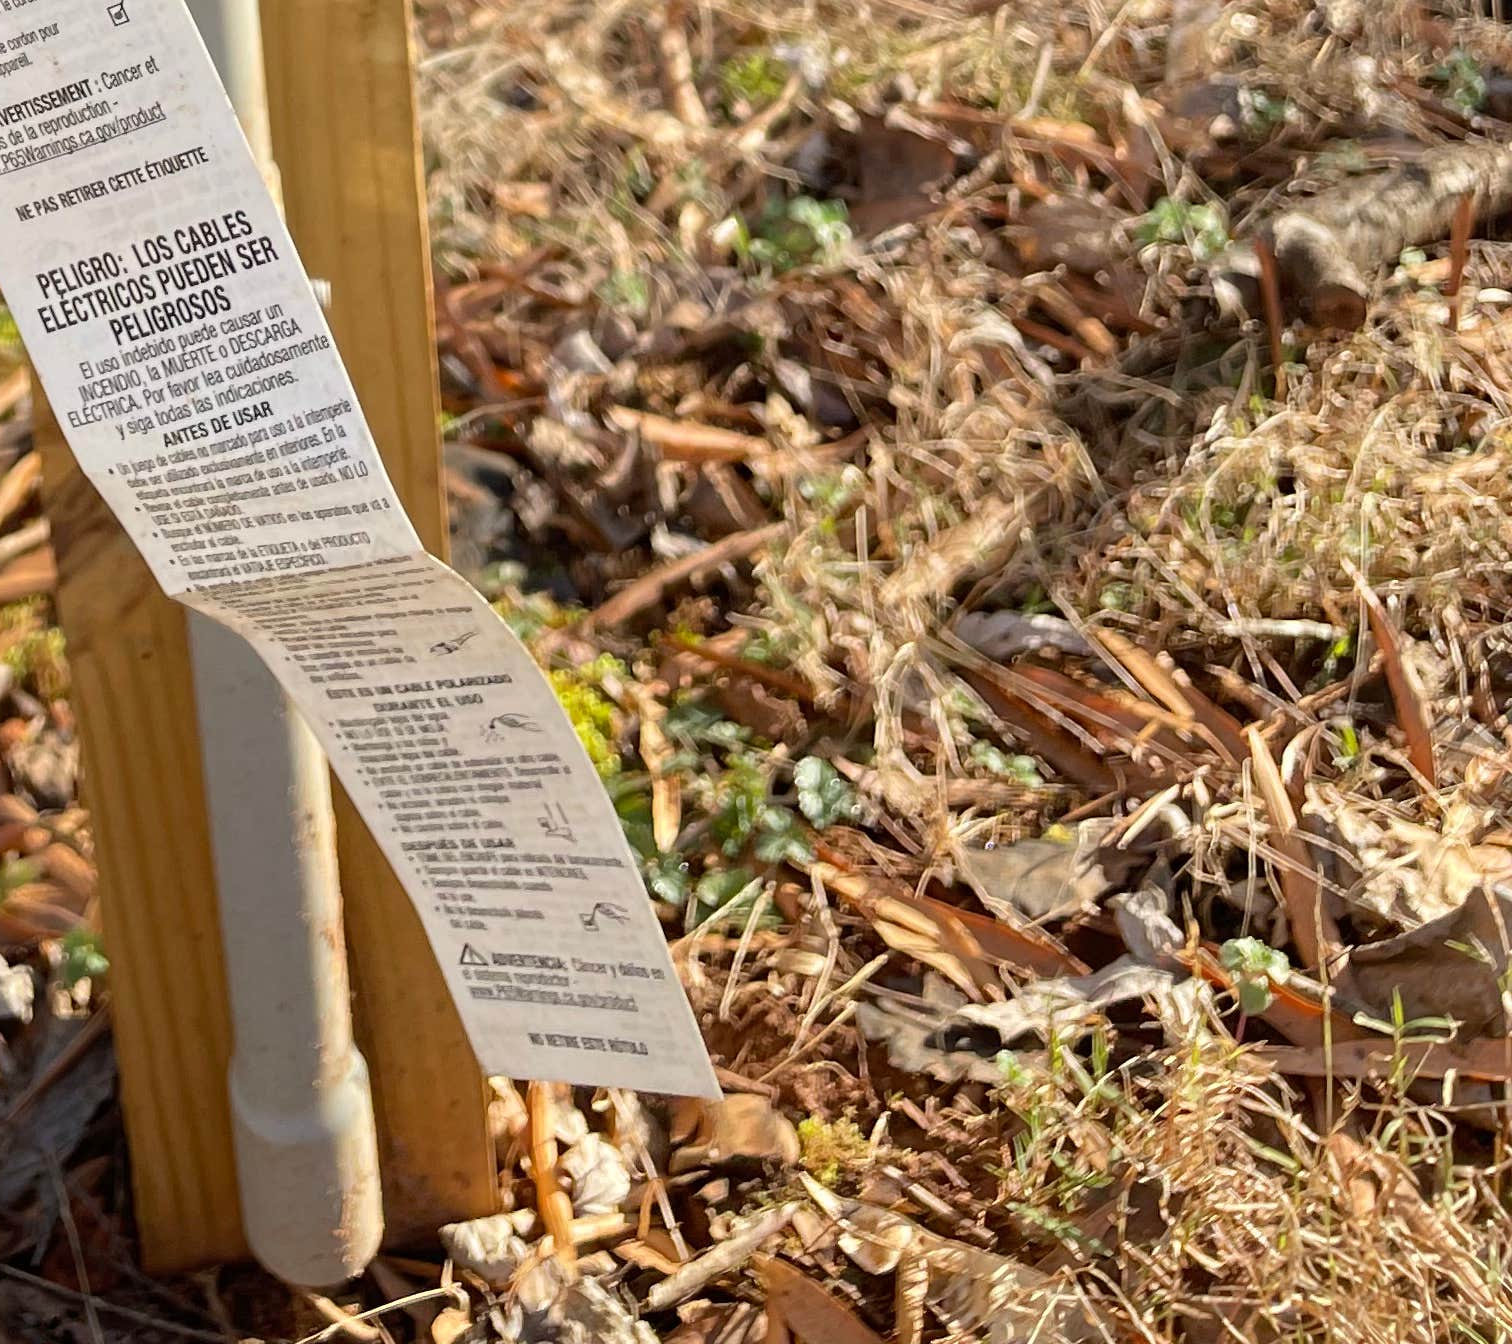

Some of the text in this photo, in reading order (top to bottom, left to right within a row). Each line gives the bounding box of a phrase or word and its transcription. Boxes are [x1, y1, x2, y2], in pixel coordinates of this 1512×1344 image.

[5, 27, 39, 51] cordon
[37, 21, 61, 42] pour
[99, 62, 143, 91] Cancer
[143, 54, 160, 75] et
[6, 126, 25, 146] de
[24, 122, 38, 140] la
[36, 97, 111, 138] reproduction
[16, 145, 209, 222] NE PAS RETIRER CETTE ÉTIQUETTE
[35, 208, 253, 301] PELIGRO: LOS CABLES
[157, 247, 237, 296] PUEDEN
[235, 234, 279, 271] SER
[79, 302, 284, 379] El uso indebido puede causar un
[109, 283, 232, 346] PELIGROSOS
[142, 385, 166, 407] Por
[165, 373, 202, 400] favor
[201, 366, 224, 389] lea
[223, 331, 330, 380] cuidadosamente
[146, 362, 161, 382] la
[161, 344, 216, 379] MUERTE
[218, 344, 229, 359] o
[228, 316, 302, 355] DESCARGA
[114, 366, 299, 441] y siga todas las indicaciones.
[162, 400, 274, 449] ANTES DE USAR
